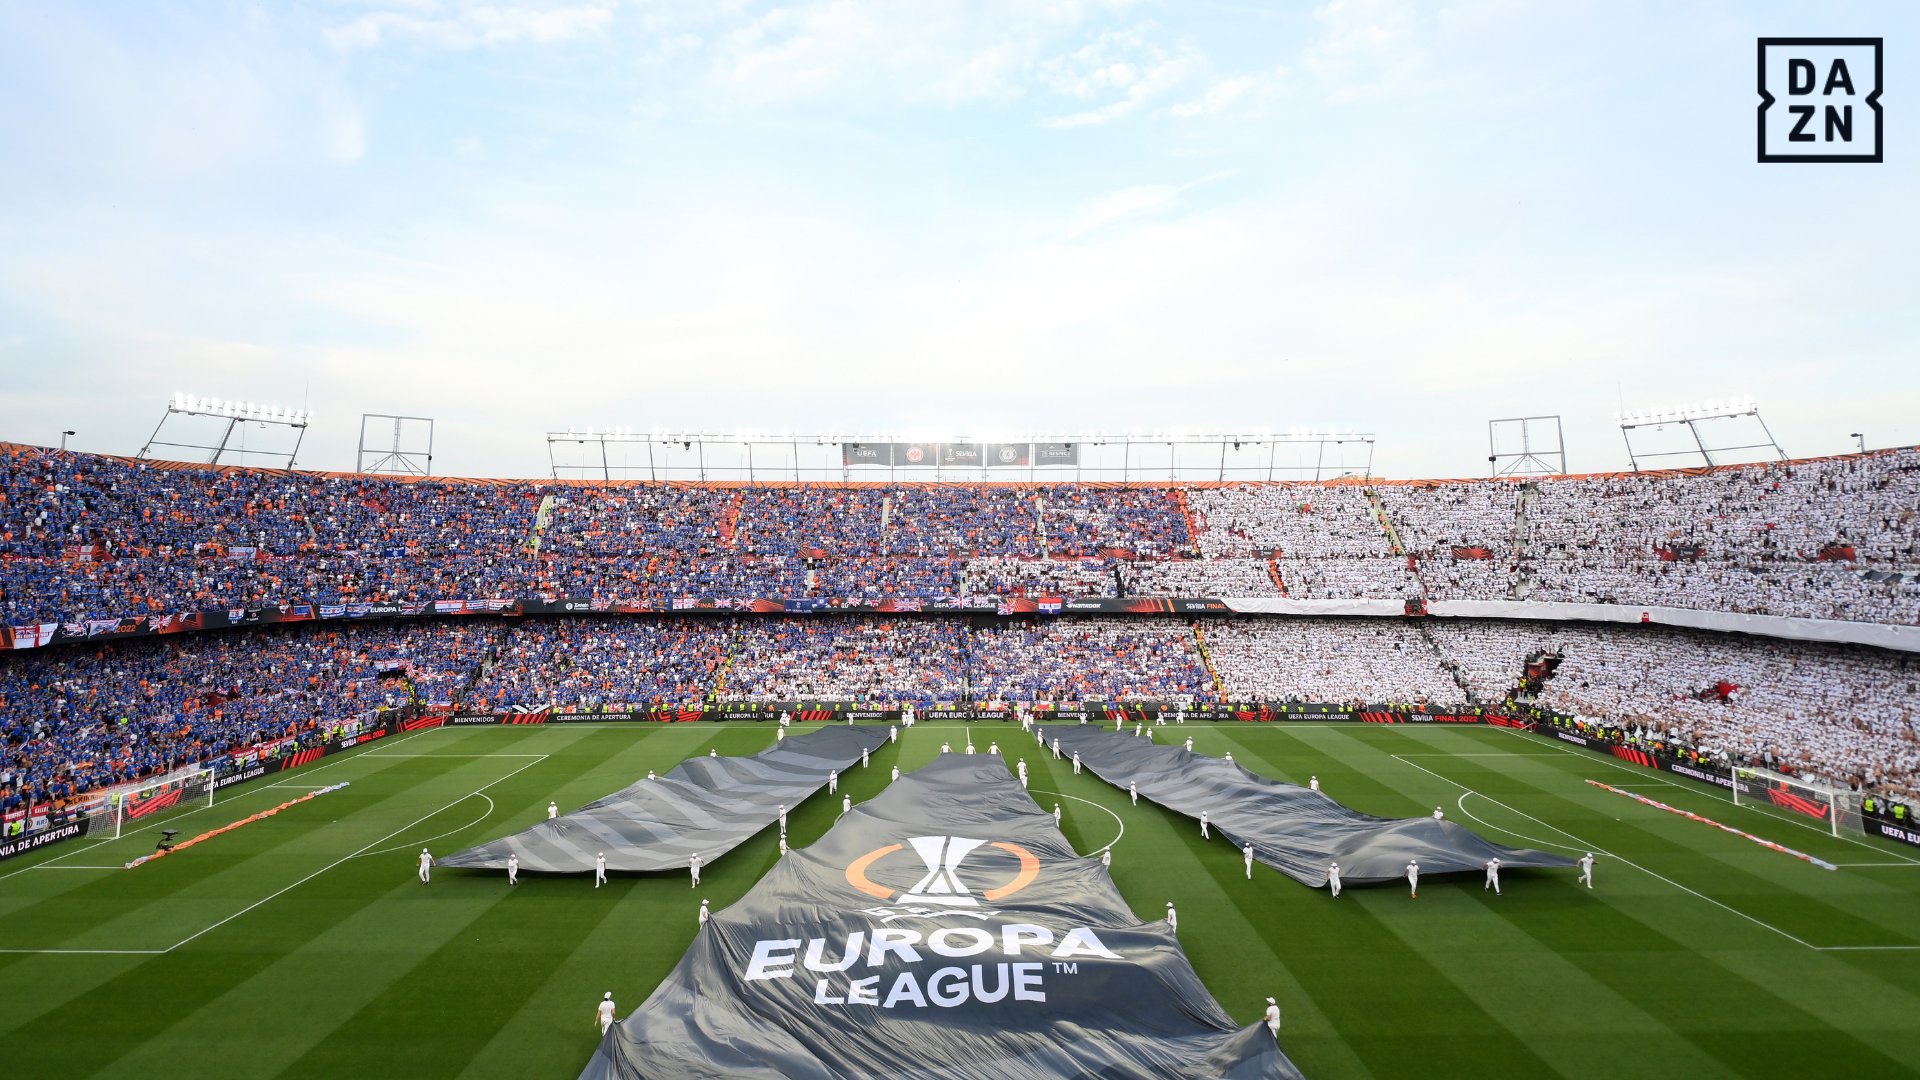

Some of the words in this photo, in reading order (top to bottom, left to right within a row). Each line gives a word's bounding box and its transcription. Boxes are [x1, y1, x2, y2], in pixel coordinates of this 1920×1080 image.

[116, 624, 136, 633] 2022
[928, 711, 948, 719] UEFA
[1411, 714, 1434, 722] SEVILLA
[1458, 715, 1479, 723] 2022
[341, 737, 357, 749] SEVILLA
[357, 733, 372, 743] FINAL
[372, 729, 386, 739] 2022
[220, 773, 243, 787] EUROPA
[243, 766, 265, 780] LEAGUE
[1671, 764, 1705, 781] CEREMONIA
[1706, 774, 1715, 784] DE
[18, 839, 31, 852] DE
[32, 824, 80, 847] APERTURA
[1881, 824, 1906, 840] UEFA
[744, 923, 1125, 981] EUROPA
[814, 961, 1046, 1009] LEAGUE
[1052, 961, 1078, 975] TM
